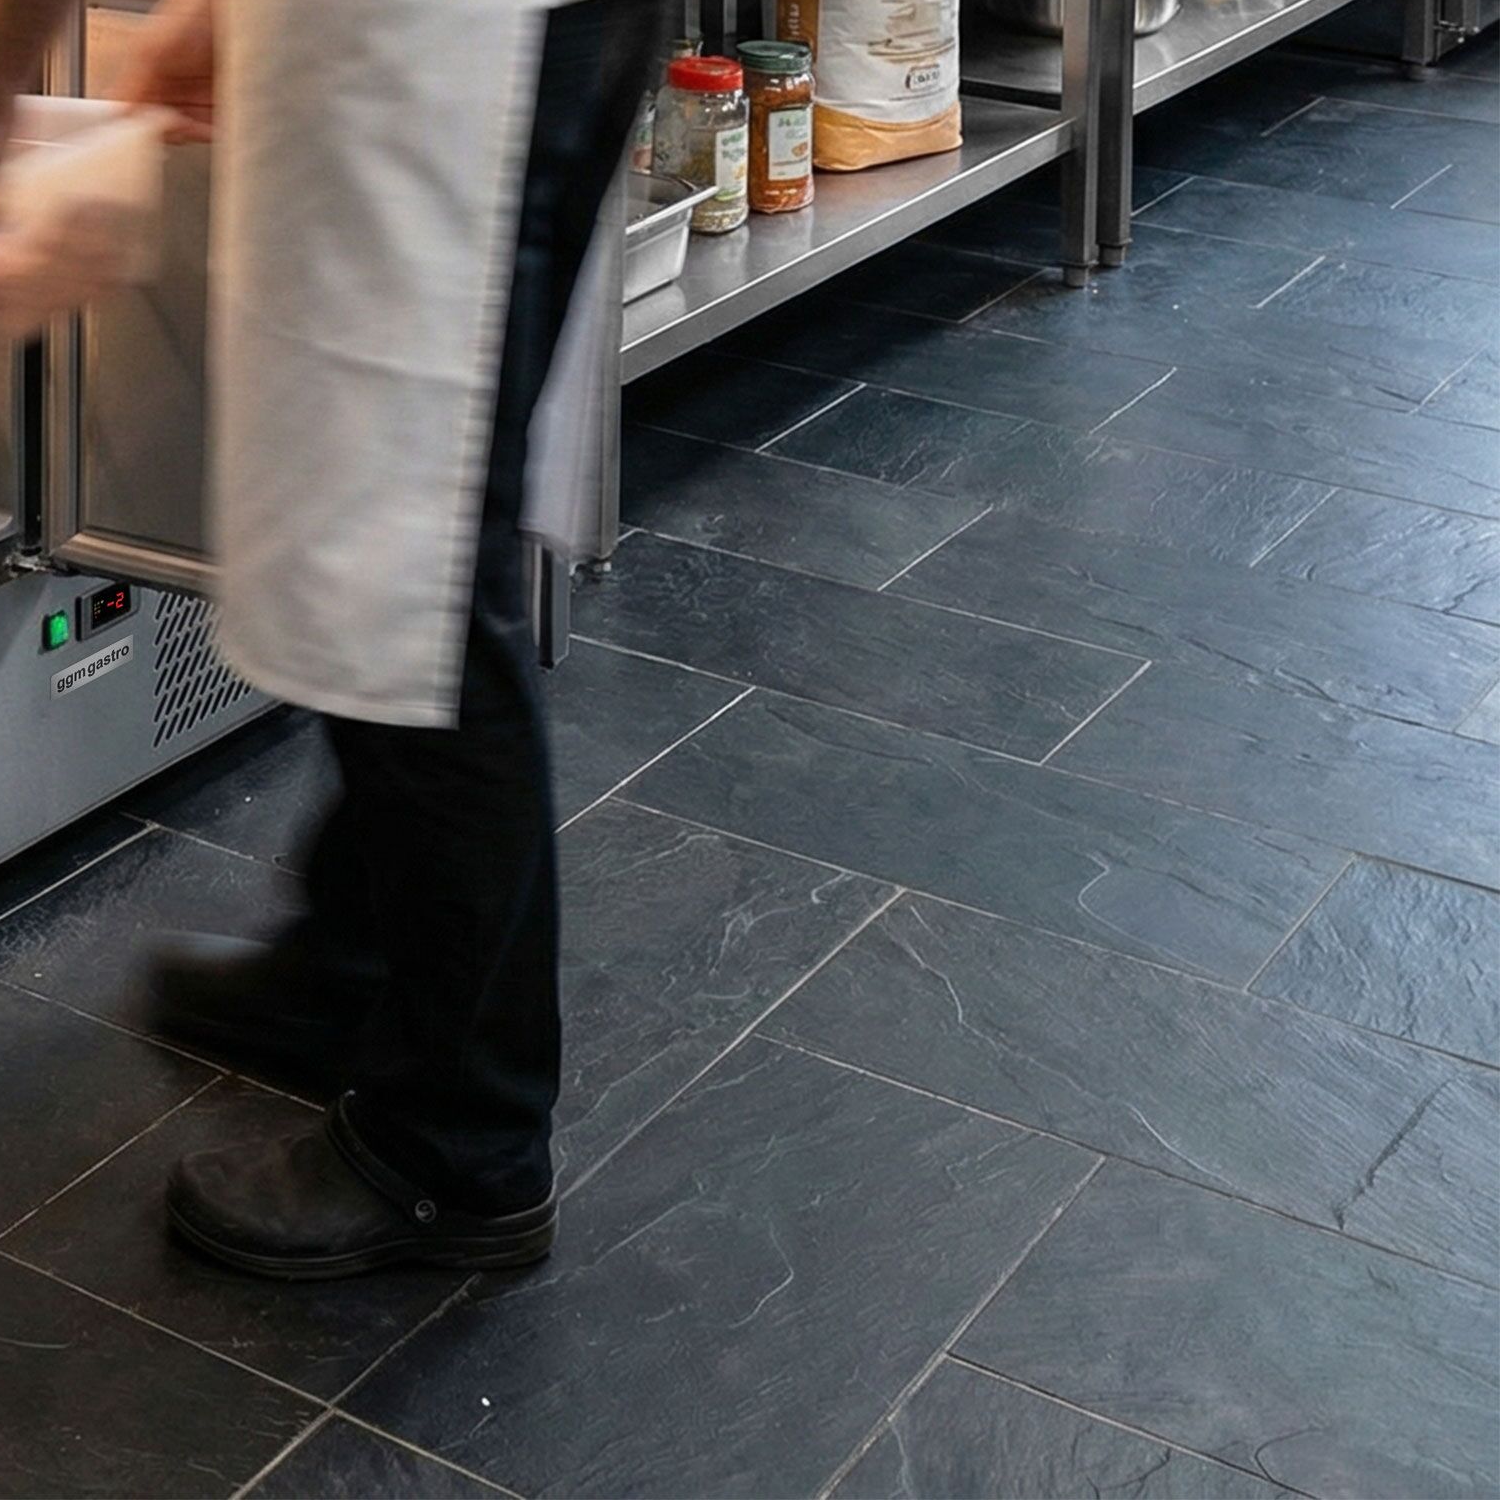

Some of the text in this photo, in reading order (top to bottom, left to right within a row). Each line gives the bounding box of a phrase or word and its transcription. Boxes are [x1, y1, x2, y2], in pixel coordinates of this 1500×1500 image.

[106, 591, 124, 609] -2
[57, 645, 130, 693] ggm gastro
